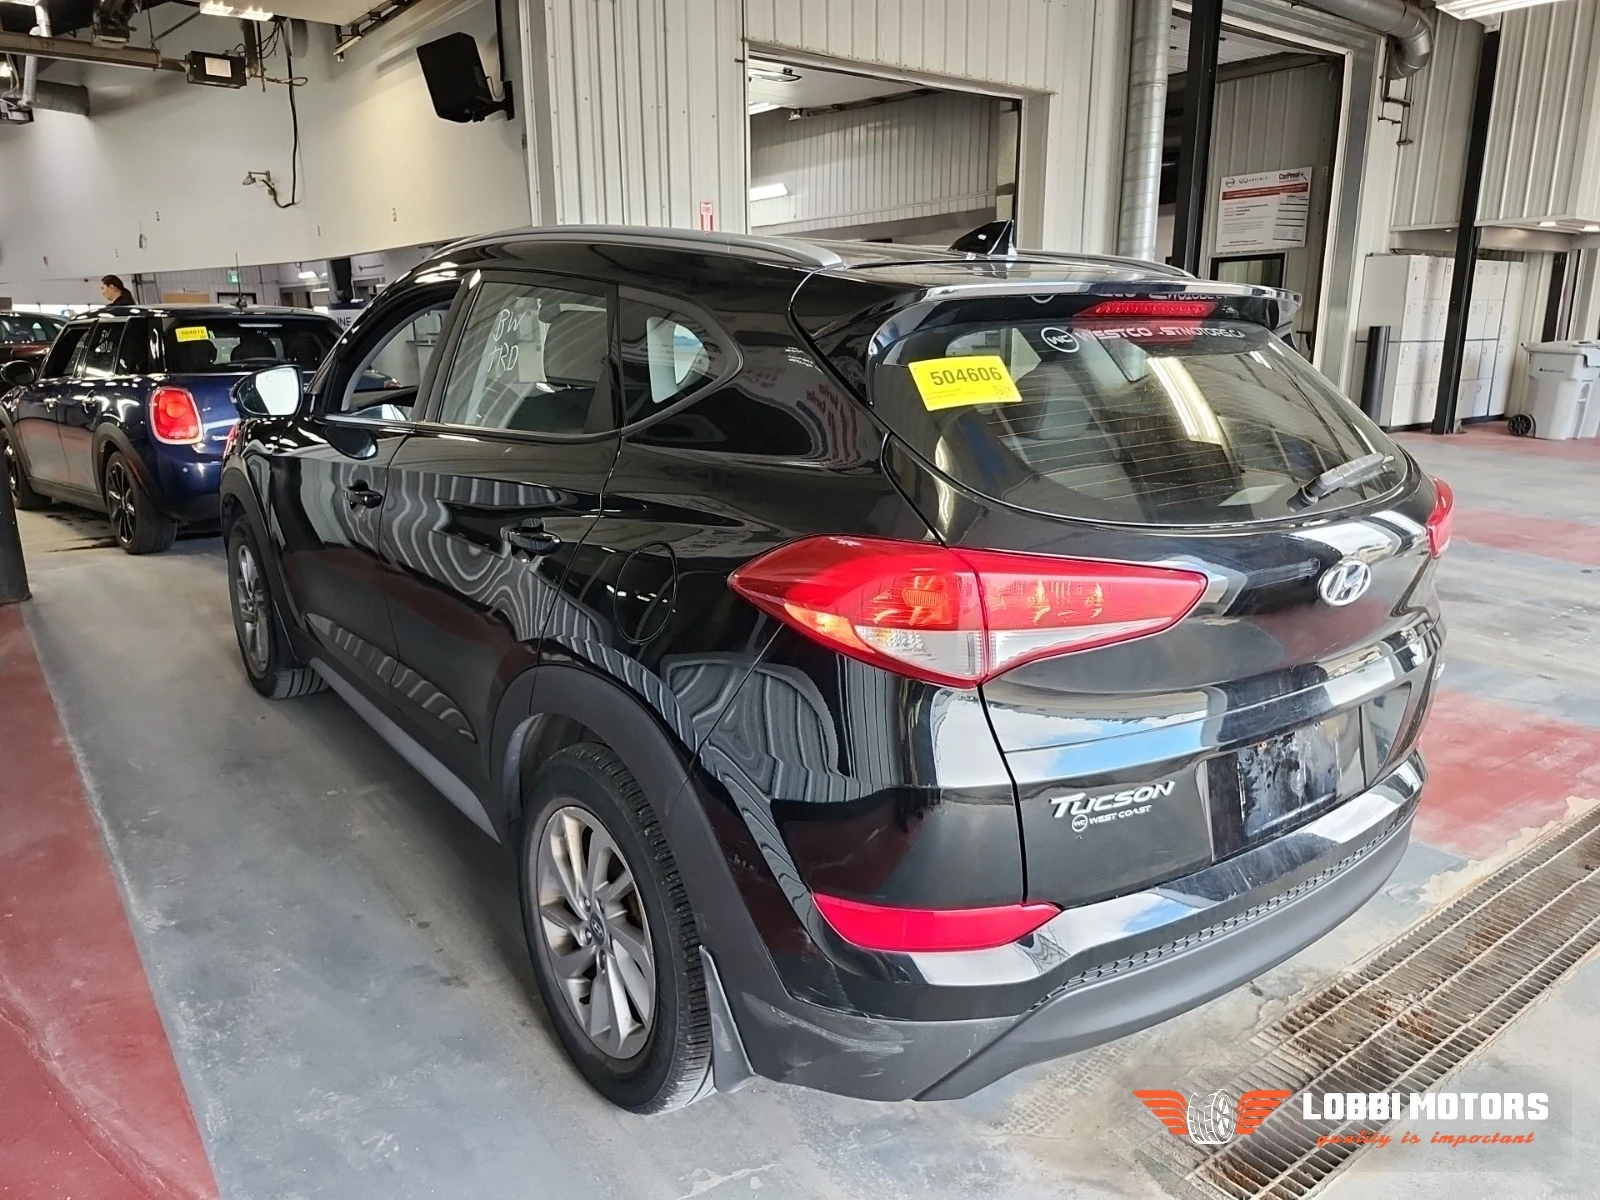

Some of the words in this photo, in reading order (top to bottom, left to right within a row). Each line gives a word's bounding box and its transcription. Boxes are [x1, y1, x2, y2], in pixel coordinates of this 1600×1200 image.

[929, 366, 1003, 387] 504606
[1089, 812, 1118, 825] WEST
[1117, 804, 1152, 819] COAST
